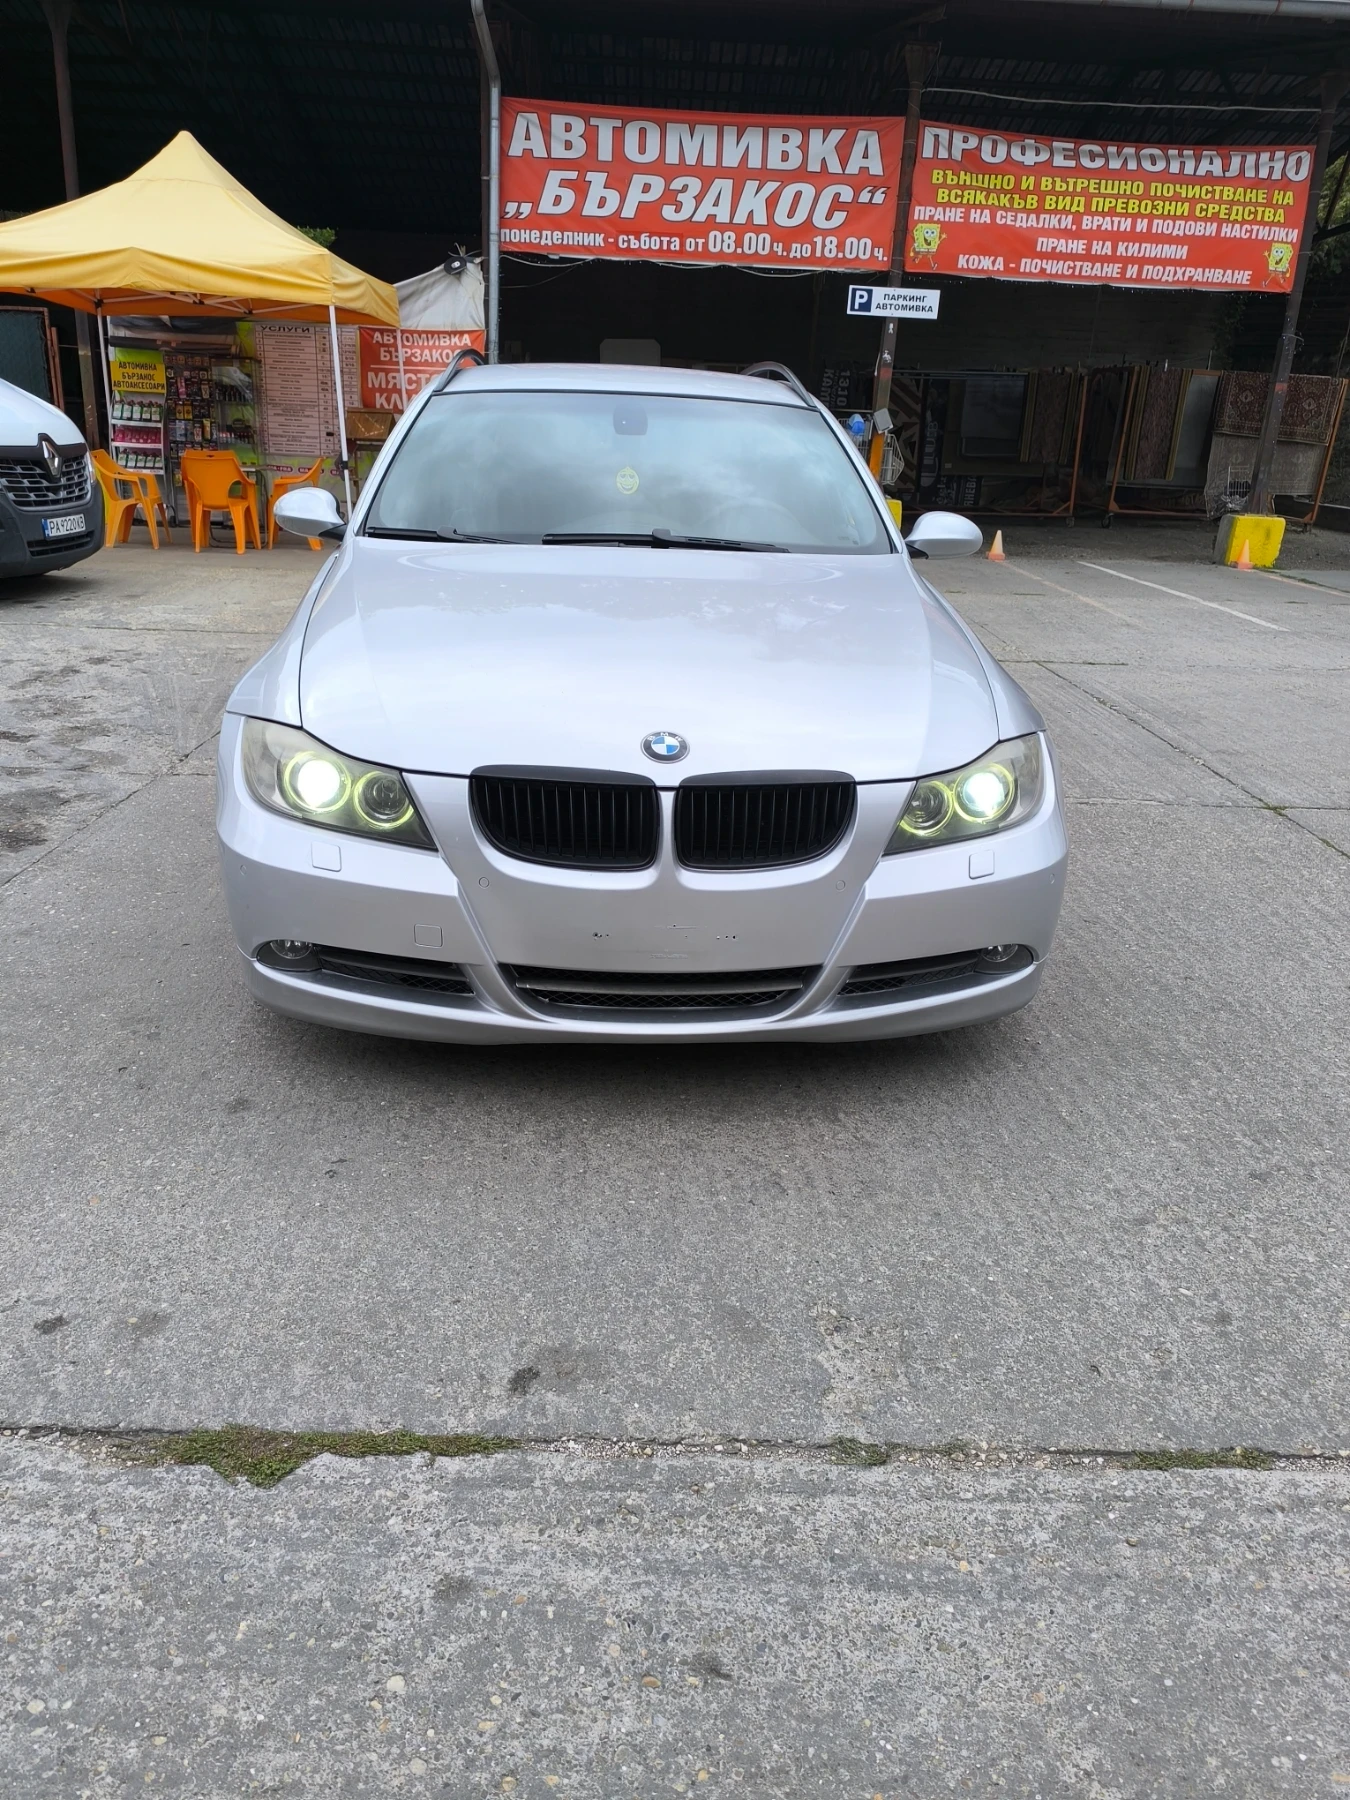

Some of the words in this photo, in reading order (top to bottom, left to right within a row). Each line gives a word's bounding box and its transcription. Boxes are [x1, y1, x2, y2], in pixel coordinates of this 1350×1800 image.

[507, 112, 884, 176] АВТОМИВКА
[921, 125, 1312, 183] ПРОФЕСИОНАЛНО
[931, 169, 1015, 191] ВЪНШНО
[1020, 174, 1035, 192] И
[1040, 176, 1143, 196] ВЪТРЕШНО
[1150, 182, 1268, 203] ПОЧИСТВАНЕ
[1272, 189, 1294, 207] НА
[936, 188, 1039, 211] ВСЯКАКЪВ
[1043, 194, 1086, 215] ВИД
[1091, 197, 1189, 218] ПРЕВОЗНИ
[1195, 203, 1286, 224] СРЕДСТВА
[913, 205, 965, 224] ПРАНЕ
[969, 208, 990, 225] НА
[995, 209, 1077, 233] СЕДАЛКИ,
[1082, 215, 1132, 233] ВРАТИ
[1135, 218, 1149, 234] И
[1152, 219, 1217, 238] ПОДОВИ
[1220, 222, 1299, 244] НАСТИЛКИ
[500, 228, 605, 247] понеделник
[618, 233, 680, 251] събота
[686, 238, 705, 252] от
[707, 230, 771, 255] 08.00
[773, 242, 787, 257] ч.
[789, 241, 811, 259] до
[813, 235, 873, 260] 18.00
[874, 246, 888, 261] ч.
[1036, 237, 1086, 255] ПРАНЕ
[1090, 240, 1113, 257] НА
[1116, 241, 1188, 261] КИЛИМИ
[957, 254, 1004, 272] КОЖА
[1019, 257, 1122, 279] ПОЧИСТВАНЕ
[1125, 263, 1139, 279] И
[1142, 264, 1253, 285] ПОДХРАНВАНЕ
[854, 290, 869, 310] P
[875, 302, 934, 313] АВТОМИВКА
[883, 293, 928, 303] ПАРКИНГ
[260, 325, 310, 333] УСЛУГИ
[119, 361, 157, 371] АВТОМИВКА
[380, 347, 464, 363] БЪРЗАКО
[113, 380, 165, 390] АВТОАКСЕСОАРИ
[122, 371, 155, 381] БЪРЗАКОС
